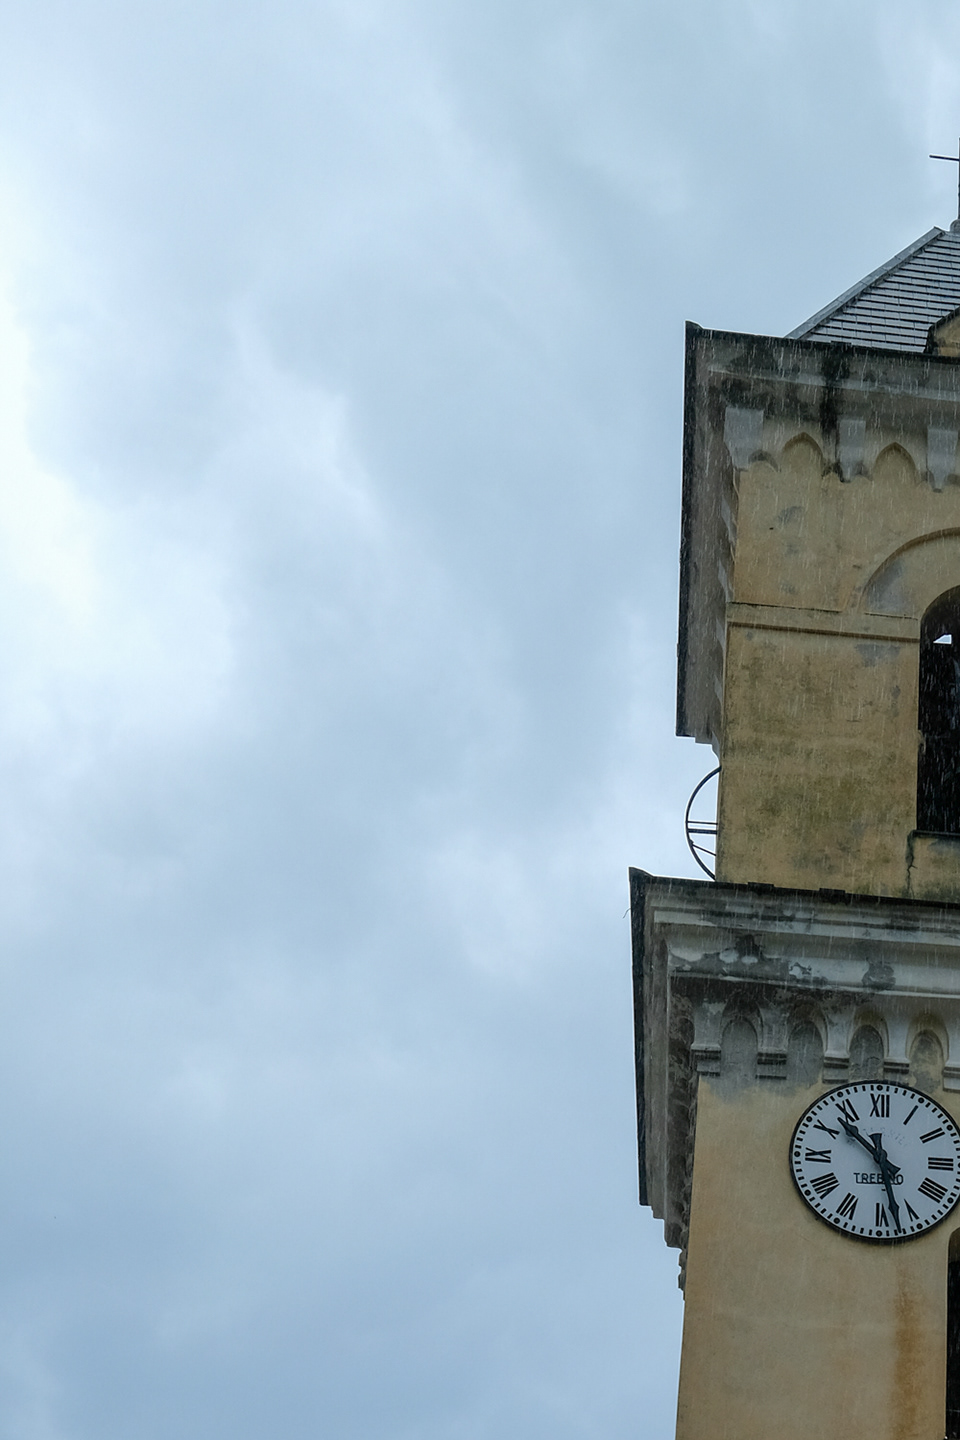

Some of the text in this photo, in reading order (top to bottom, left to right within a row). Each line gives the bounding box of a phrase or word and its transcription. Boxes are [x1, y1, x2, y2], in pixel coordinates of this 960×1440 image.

[870, 1093, 890, 1118] XII
[928, 1157, 954, 1171] III
[853, 1172, 904, 1185] TREBNO
